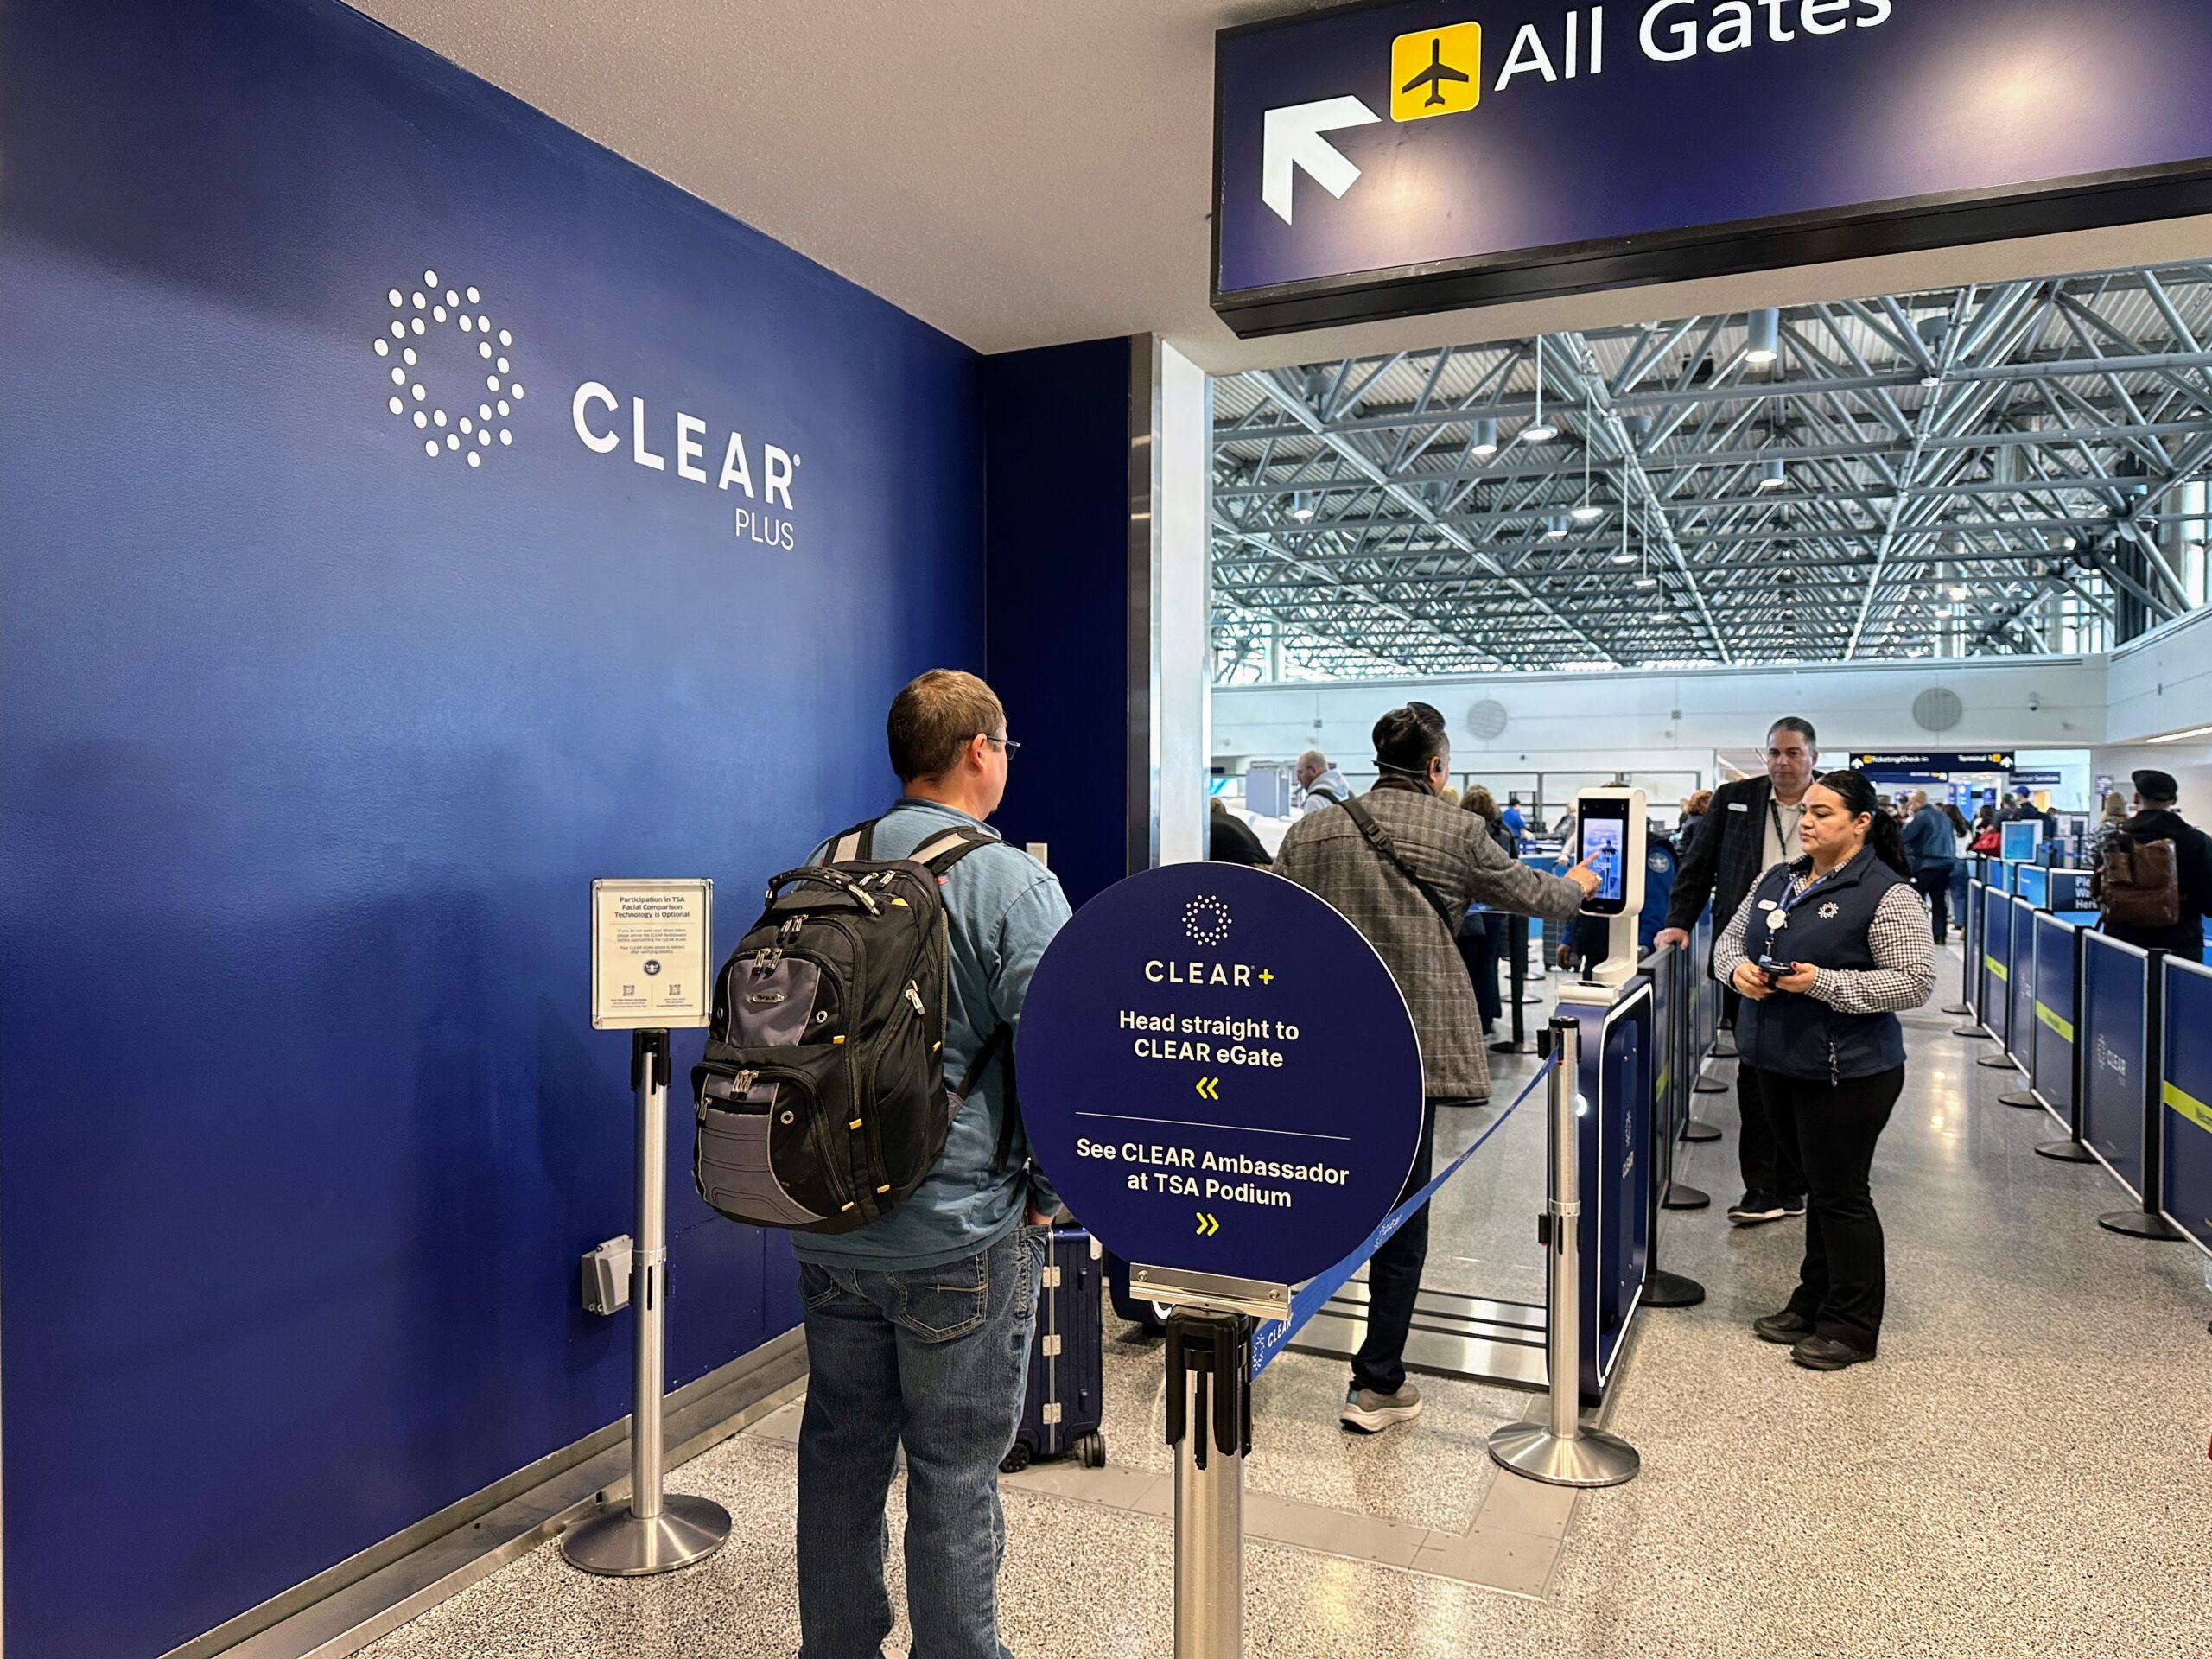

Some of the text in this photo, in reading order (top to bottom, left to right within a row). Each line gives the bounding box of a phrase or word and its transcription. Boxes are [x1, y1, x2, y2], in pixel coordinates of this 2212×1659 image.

[1494, 0, 1892, 92] All Gates
[735, 507, 794, 550] PLUS
[1120, 1010, 1300, 1042] Head straight to
[1134, 1038, 1284, 1068] CLEAR eGate
[1077, 1138, 1350, 1185] See CLEAR Ambassador
[1127, 1173, 1292, 1208] at TSA Podium
